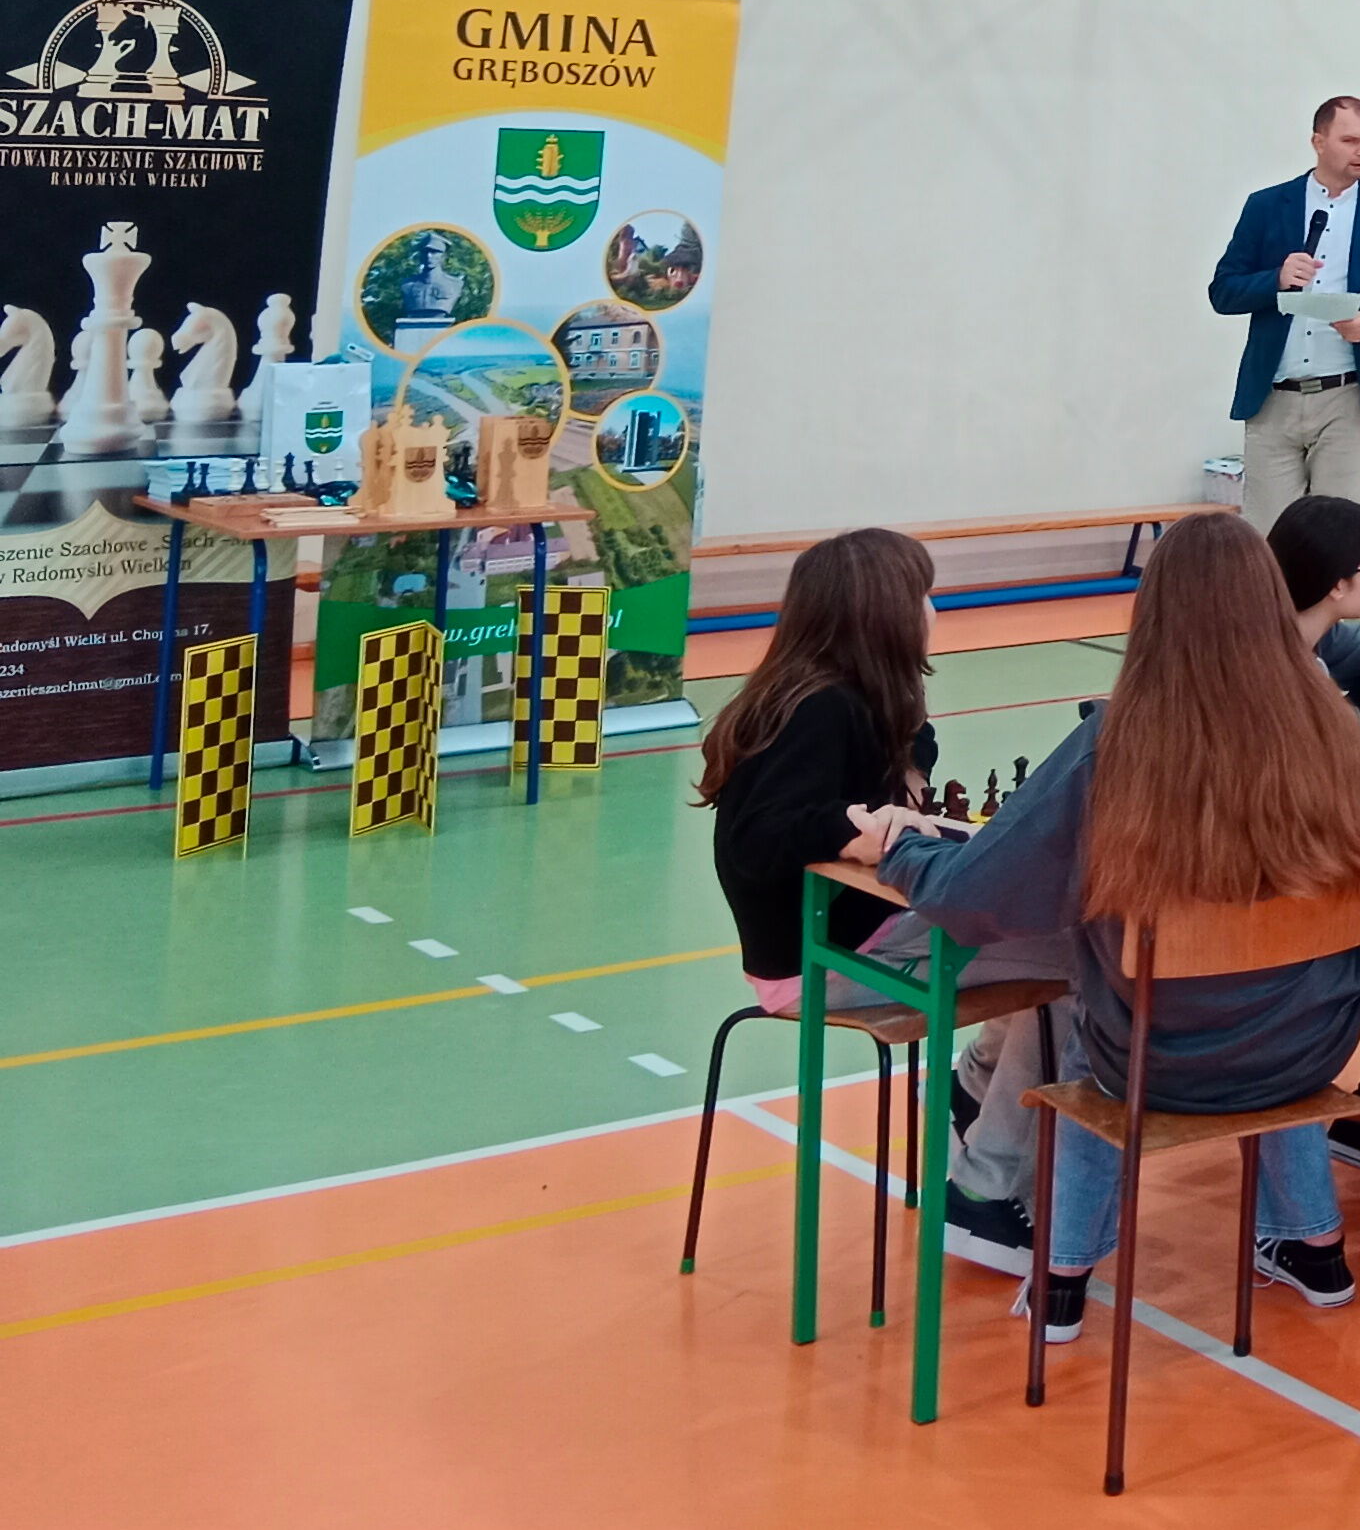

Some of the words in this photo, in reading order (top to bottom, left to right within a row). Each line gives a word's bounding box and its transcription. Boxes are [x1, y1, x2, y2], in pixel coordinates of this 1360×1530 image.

[456, 7, 658, 58] GMINA
[452, 56, 656, 89] GRĘBOSZÓW
[0, 98, 269, 142] SZACH-MAT
[164, 151, 264, 172] SZACHOWE
[50, 170, 137, 187] RADOMYŚL
[147, 172, 208, 188] WIELKI
[60, 538, 149, 558] Szachowe
[121, 556, 192, 575] Wielkm
[64, 632, 107, 648] Wielki
